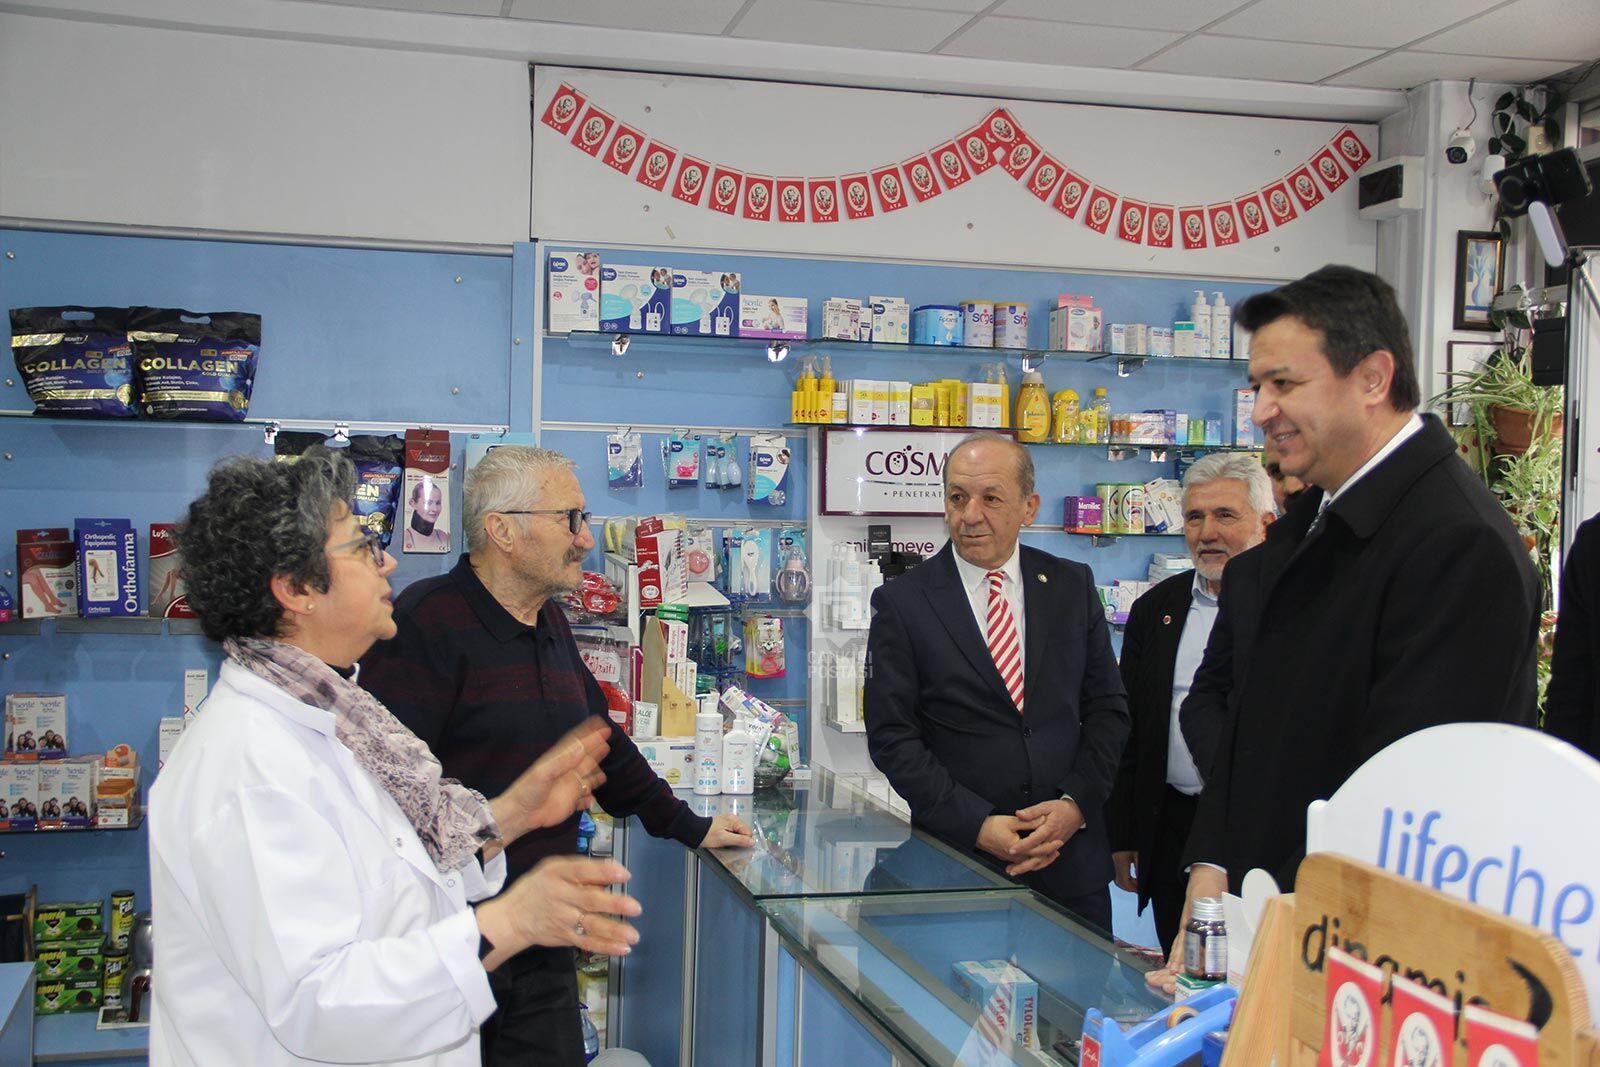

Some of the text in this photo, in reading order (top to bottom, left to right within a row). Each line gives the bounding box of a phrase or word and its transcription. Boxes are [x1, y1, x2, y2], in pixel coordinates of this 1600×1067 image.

[24, 358, 127, 374] COLLAGEN
[140, 357, 239, 373] COLLAGEN
[122, 533, 138, 612] Orthofarma
